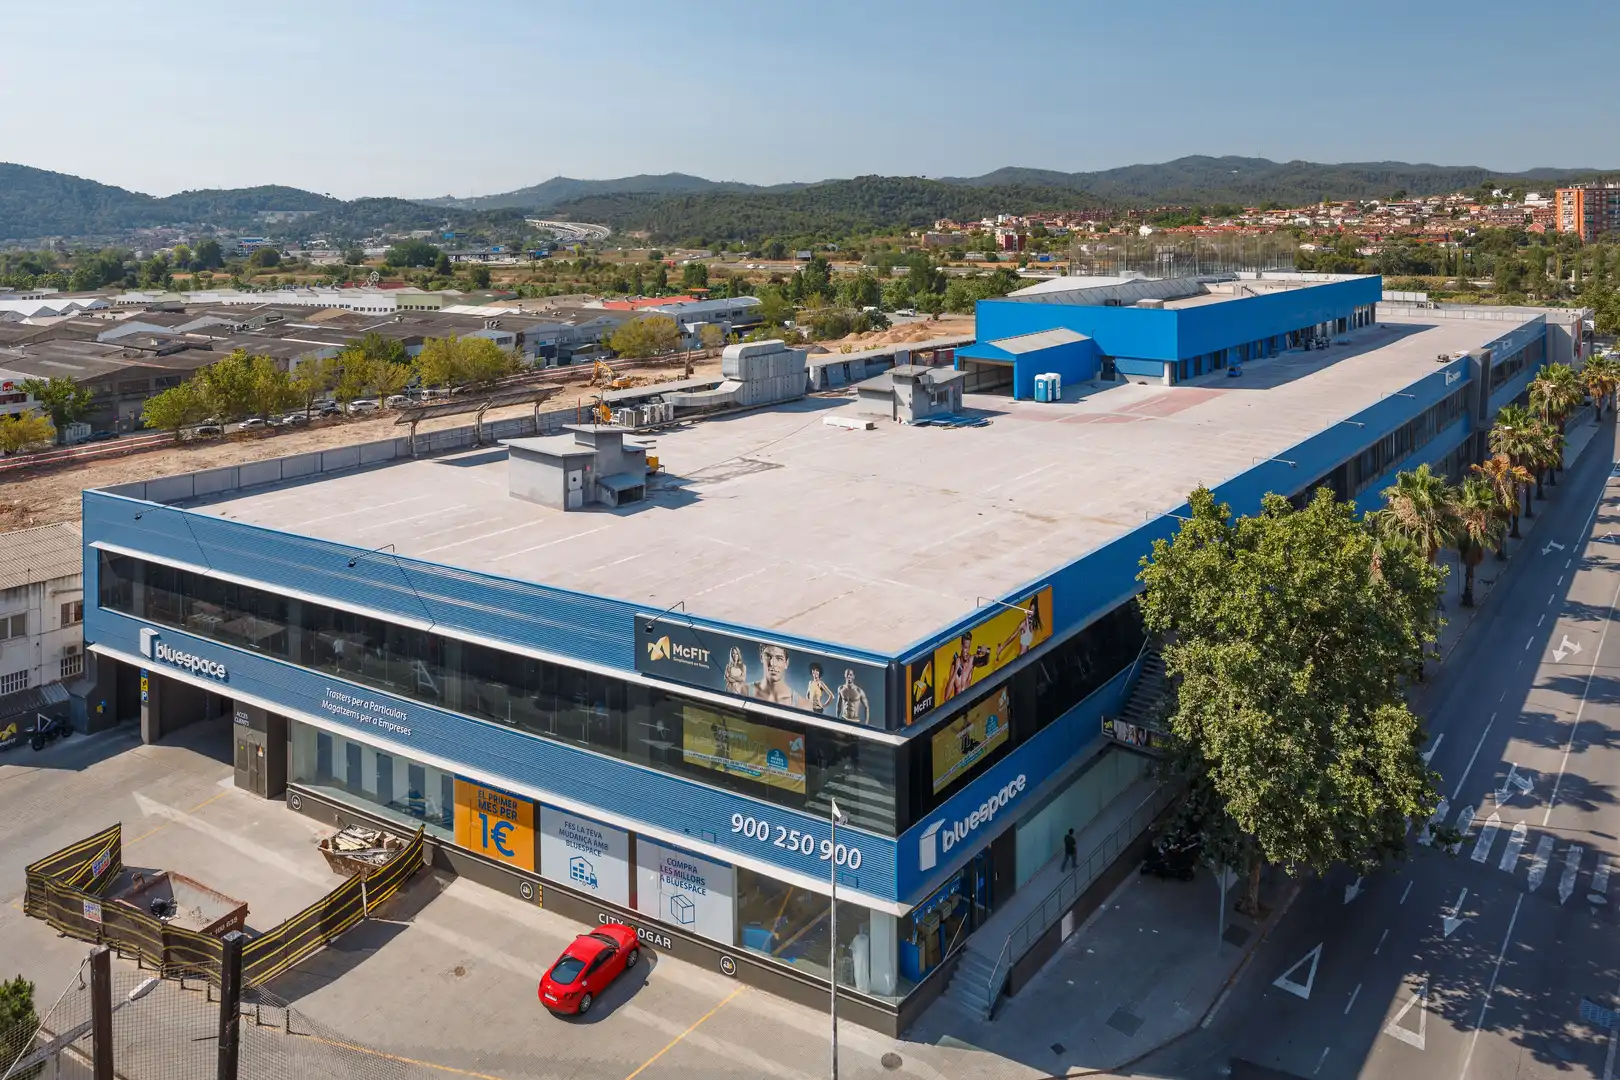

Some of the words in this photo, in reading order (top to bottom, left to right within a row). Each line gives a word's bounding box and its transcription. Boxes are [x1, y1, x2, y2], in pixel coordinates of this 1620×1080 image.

[155, 641, 226, 678] bluespace
[672, 643, 710, 662] McFIT
[326, 687, 351, 704] Trasters
[351, 696, 363, 707] per
[369, 701, 407, 721] Particulars
[913, 696, 933, 715] McFIT
[321, 700, 360, 720] Magatzems
[360, 713, 372, 723] per
[372, 717, 378, 725] a
[378, 717, 412, 736] Empreses
[477, 789, 487, 800] EL
[488, 793, 518, 810] PRIMER
[477, 800, 498, 815] MES
[499, 807, 518, 821] PER
[942, 773, 1027, 853] bluespace
[558, 828, 593, 846] MUDANÇA
[593, 839, 609, 851] AMB
[564, 821, 575, 833] FES
[576, 824, 586, 835] LA
[585, 827, 603, 840] TEVA
[565, 840, 602, 858] BLUESPACE
[731, 813, 770, 842] 900
[773, 826, 815, 856] 250
[819, 839, 862, 870] 900
[660, 865, 673, 875] LES
[673, 868, 706, 886] MILLORS
[666, 857, 698, 874] COMPRA
[666, 875, 707, 896] BLUESPACE
[598, 913, 624, 926] CITY
[637, 927, 673, 950] OGAR
